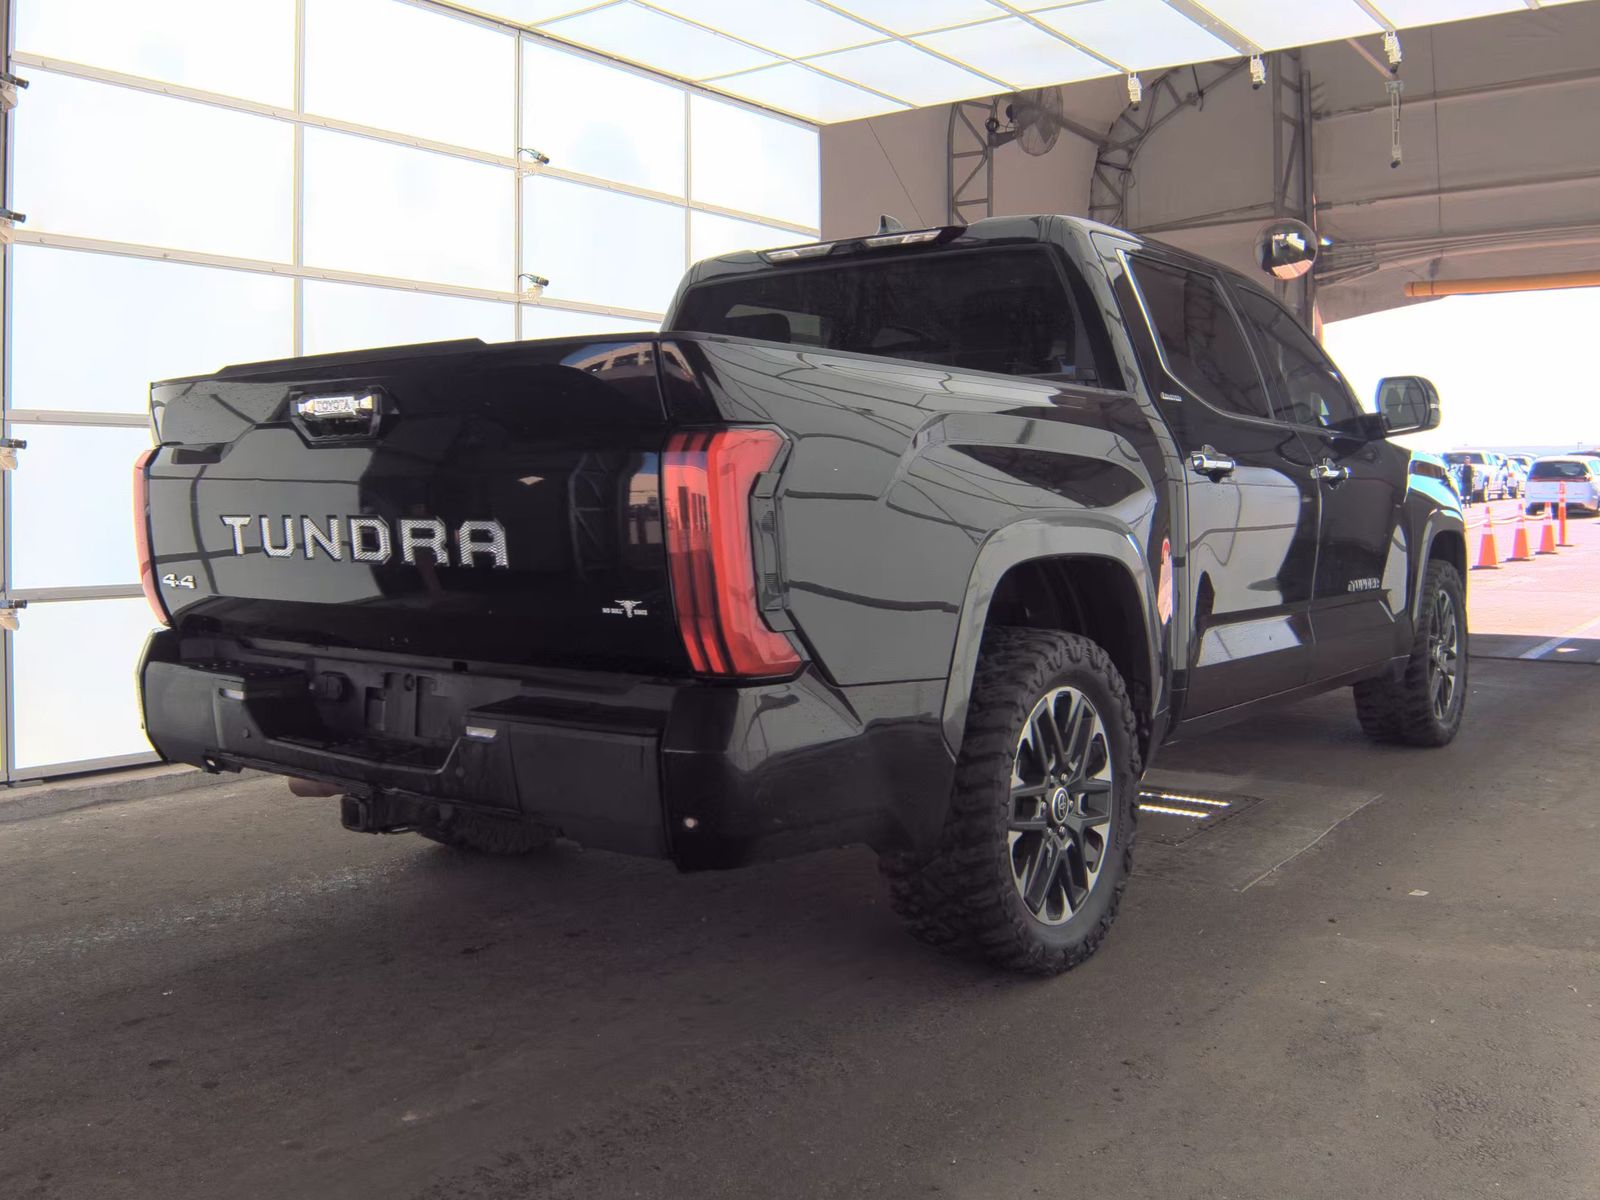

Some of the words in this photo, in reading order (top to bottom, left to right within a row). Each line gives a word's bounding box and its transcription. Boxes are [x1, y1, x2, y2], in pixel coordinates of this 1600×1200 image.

[316, 399, 351, 410] TOYOTA
[220, 515, 508, 568] TUNDRA
[163, 573, 196, 589] 4x4
